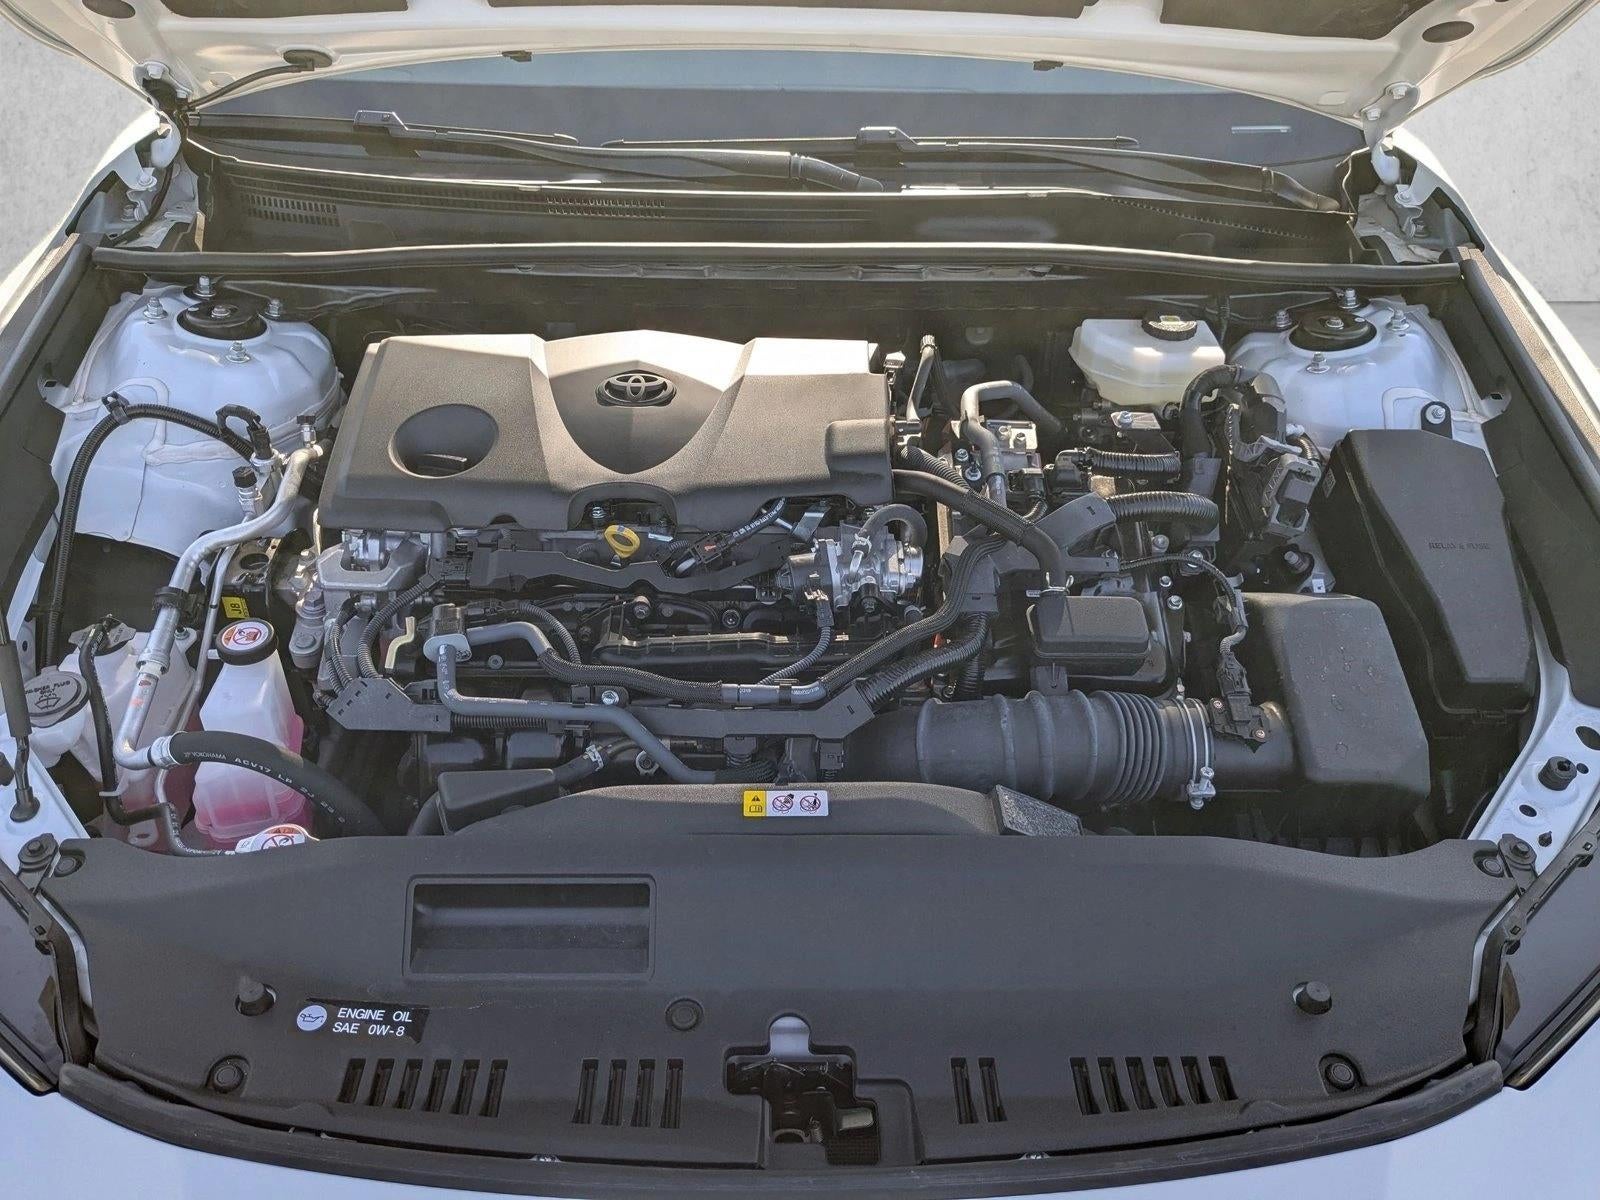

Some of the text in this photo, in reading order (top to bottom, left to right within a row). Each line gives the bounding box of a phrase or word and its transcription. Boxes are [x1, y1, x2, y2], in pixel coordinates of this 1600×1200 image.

[192, 751, 227, 760] YOKOHAMA
[337, 1007, 413, 1023] ENGINE OIL
[332, 1021, 406, 1037] SAE 0W-8
